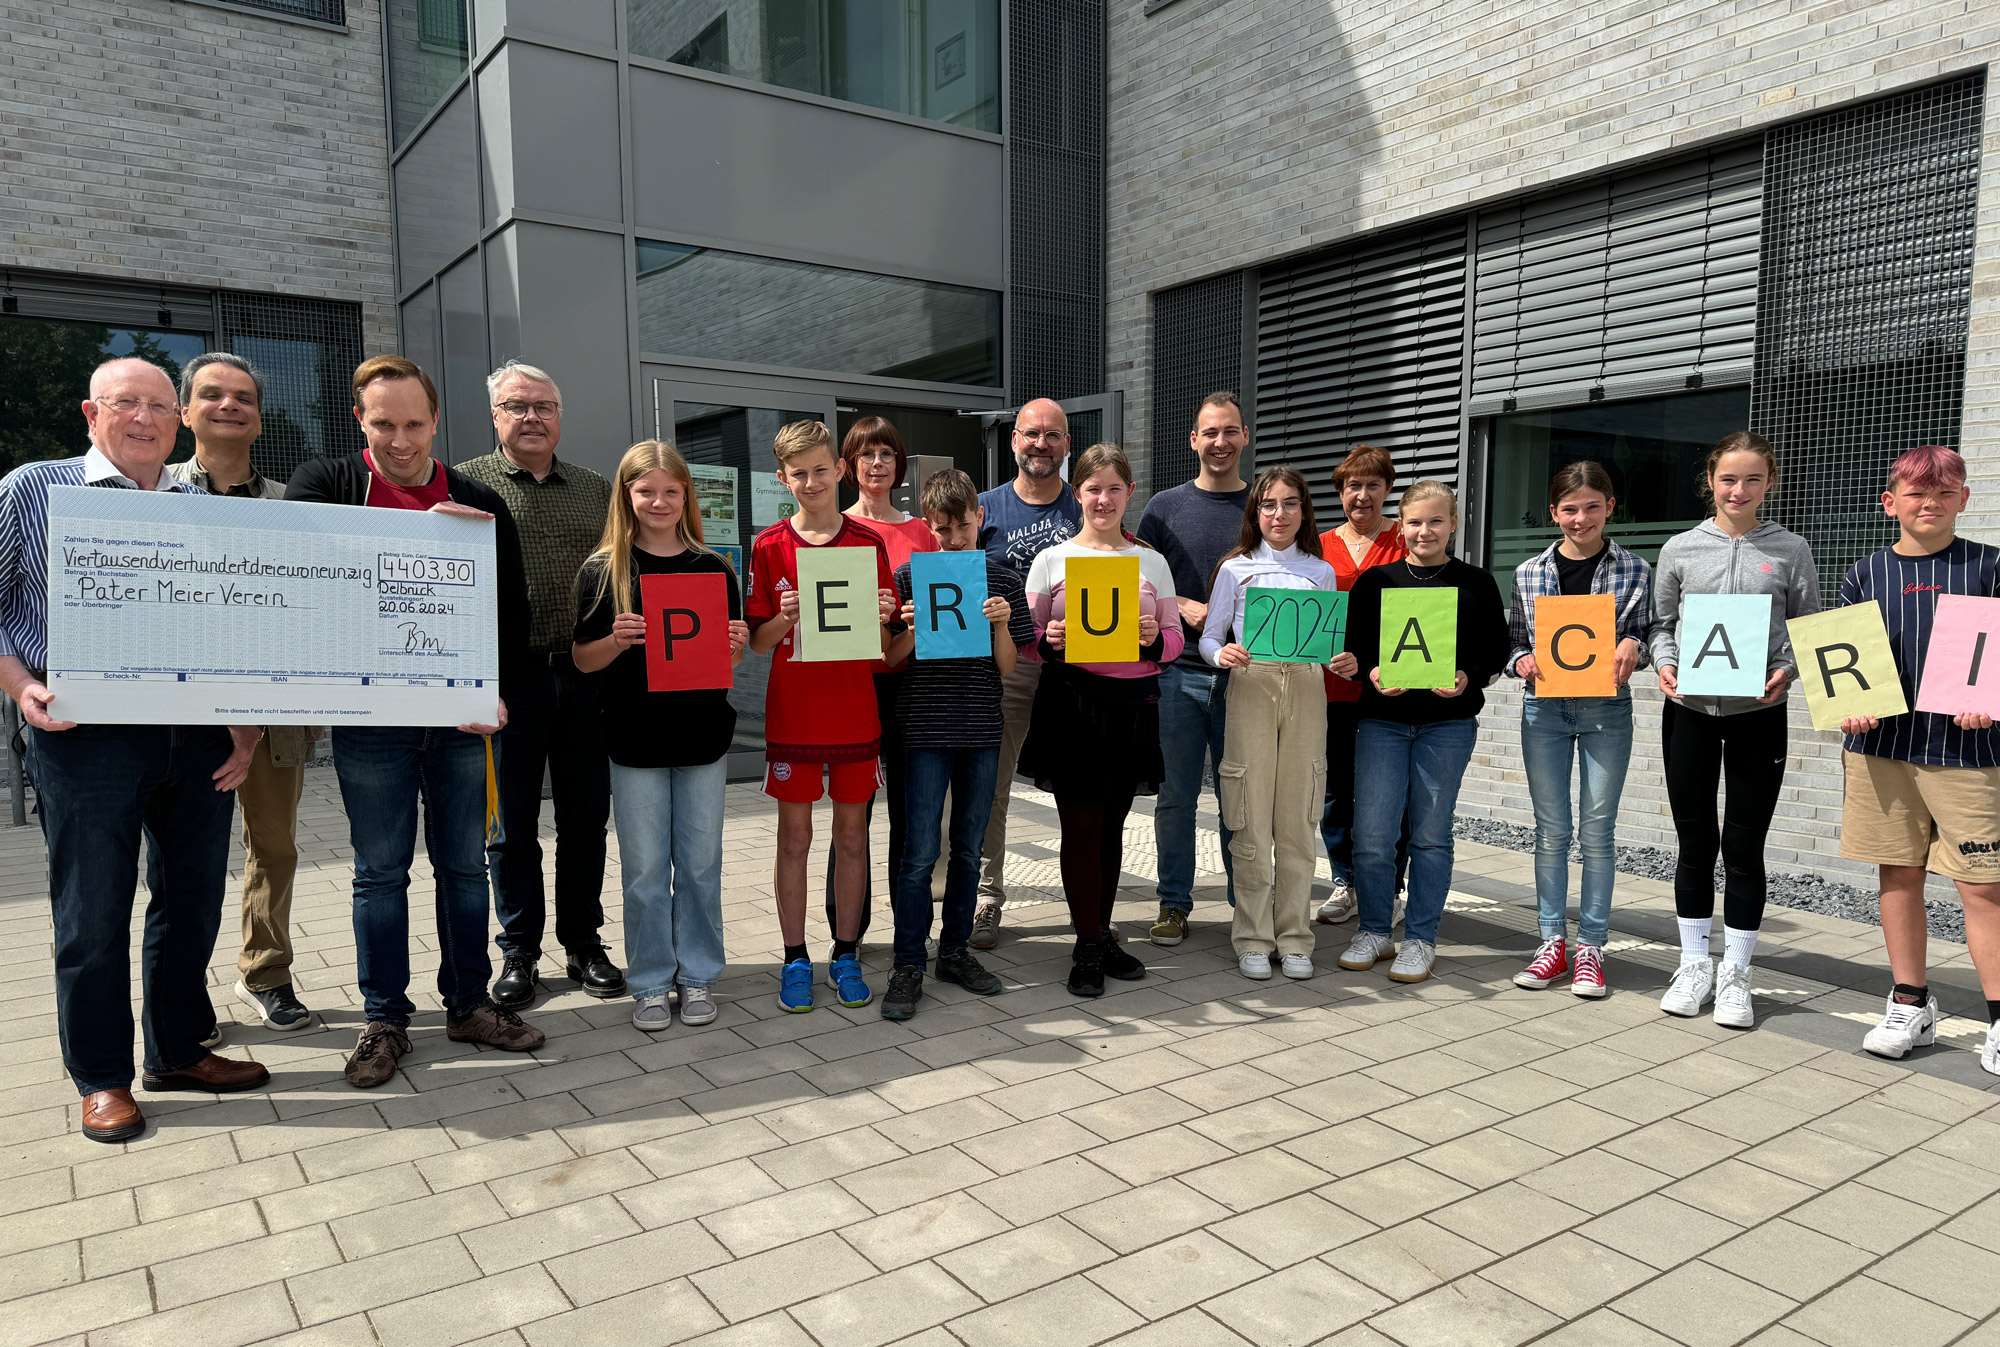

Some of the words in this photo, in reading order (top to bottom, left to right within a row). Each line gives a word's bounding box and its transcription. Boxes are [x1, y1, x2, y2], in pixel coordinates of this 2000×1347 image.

[755, 487, 790, 496] Gymnasium
[64, 535, 90, 543] Zahlen
[105, 538, 129, 547] gegen
[130, 540, 156, 548] diesen
[156, 541, 186, 549] Scheck
[1007, 518, 1053, 543] MALOJA
[64, 568, 88, 577] Betrag
[88, 569, 96, 577] in
[96, 569, 139, 578] Buchstaben
[383, 557, 471, 582] 4403,90
[77, 576, 148, 601] Pater
[156, 579, 216, 603] Meier
[219, 582, 288, 608] Verein
[376, 580, 437, 597] Delbrück
[378, 594, 424, 603] Ausstellungsort
[774, 584, 793, 592] adidas
[82, 600, 124, 610] Überbringer
[378, 600, 455, 615] 20.06.2024
[815, 580, 852, 633] E
[928, 582, 968, 632] R
[1081, 587, 1119, 637] U
[662, 607, 701, 662] P
[1248, 594, 1346, 661] 2024
[1390, 617, 1433, 663] A
[378, 649, 414, 657] Unterschrift
[426, 650, 459, 658] Ausstellers
[1550, 623, 1597, 671] C
[1691, 623, 1740, 670] A
[1966, 631, 1988, 687] I
[103, 672, 142, 680] Scheck-Nr.
[408, 679, 429, 687] Betrag
[1814, 642, 1872, 699] R
